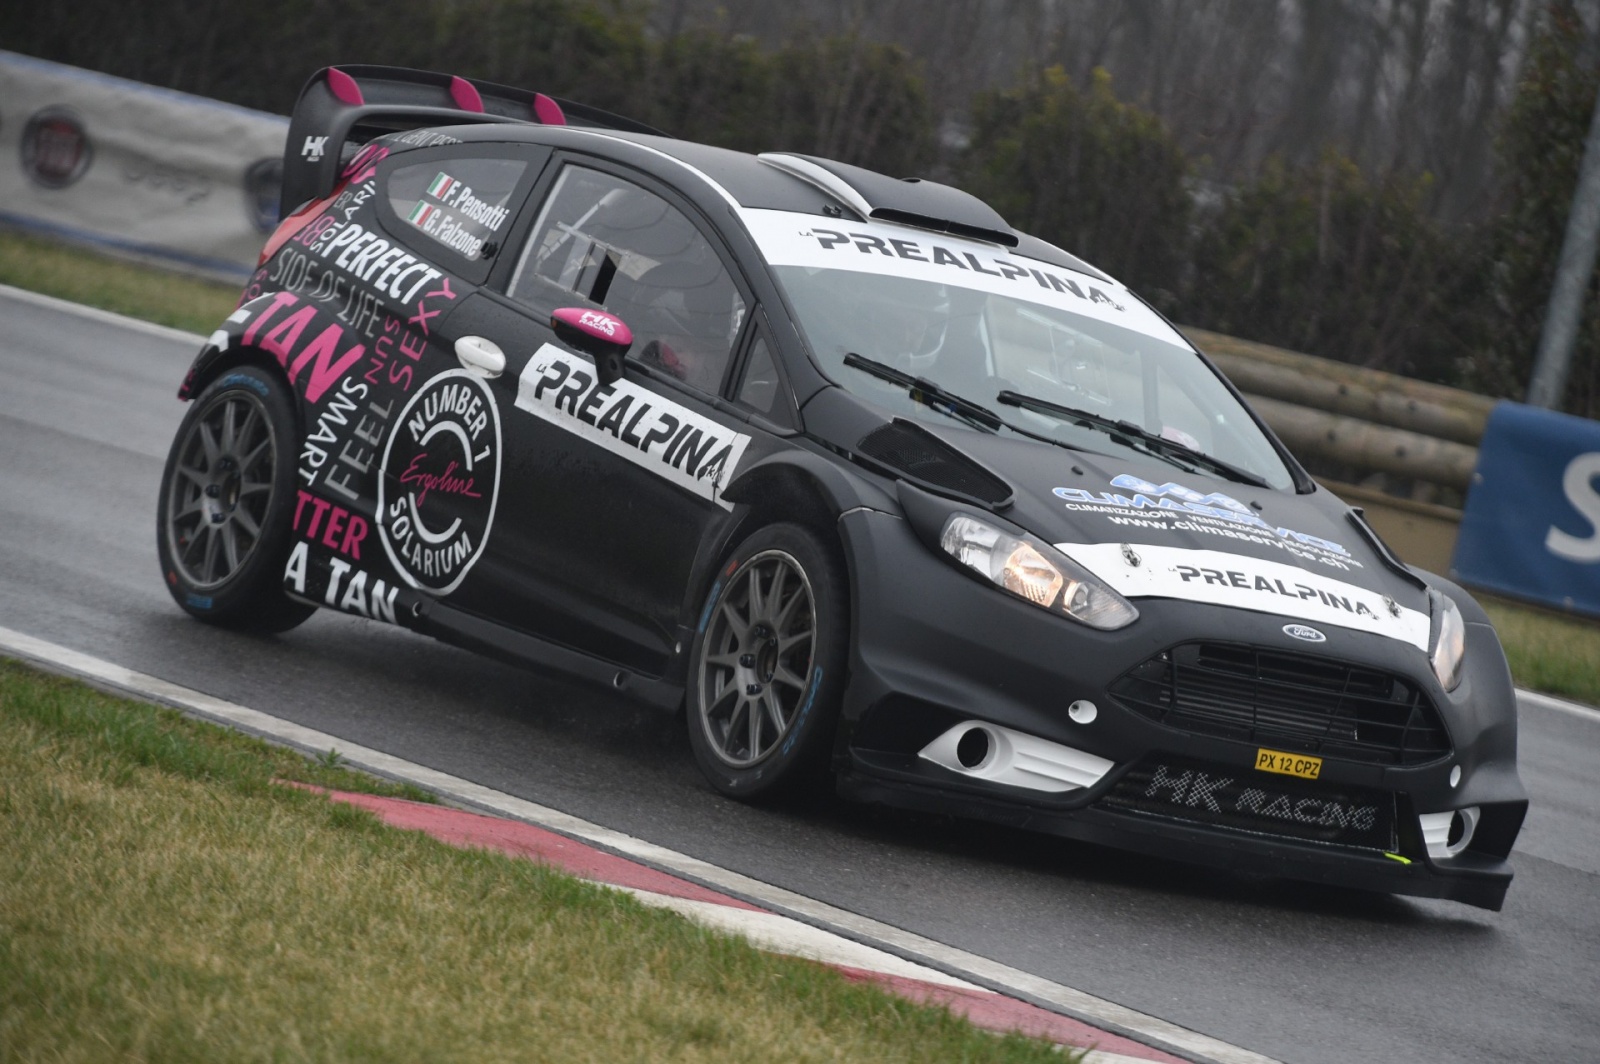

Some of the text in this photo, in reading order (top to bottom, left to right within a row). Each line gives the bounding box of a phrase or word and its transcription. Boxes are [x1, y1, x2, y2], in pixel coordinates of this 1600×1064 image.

[301, 135, 330, 156] HK
[309, 180, 376, 253] SOLARI
[423, 208, 482, 256] G.Falzone
[441, 180, 511, 232] F.Pensotti
[269, 247, 318, 292] SIDE
[336, 285, 384, 338] LIFE
[321, 224, 442, 305] PERFECT
[811, 228, 1114, 305] PREALPINA
[241, 291, 366, 404] TAN
[364, 315, 401, 385] SUN
[389, 277, 457, 392] SEXY
[578, 318, 615, 337] RACING
[581, 311, 621, 331] HK
[298, 376, 368, 487] SMART
[324, 399, 394, 500] FEEL
[408, 384, 490, 462] NUMBER 1
[534, 360, 733, 482] PREALPINA
[399, 453, 482, 507] Ergoline
[1065, 503, 1179, 519] CLIMATIZZAZIONE
[390, 496, 473, 577] SOLARIUM
[1107, 516, 1350, 571] www.climaservice.ch
[283, 541, 399, 625] A TAN
[1176, 565, 1374, 617] PREALPINA
[1145, 765, 1377, 831] HK RACING
[1258, 754, 1320, 776] PX 12 CPZ
